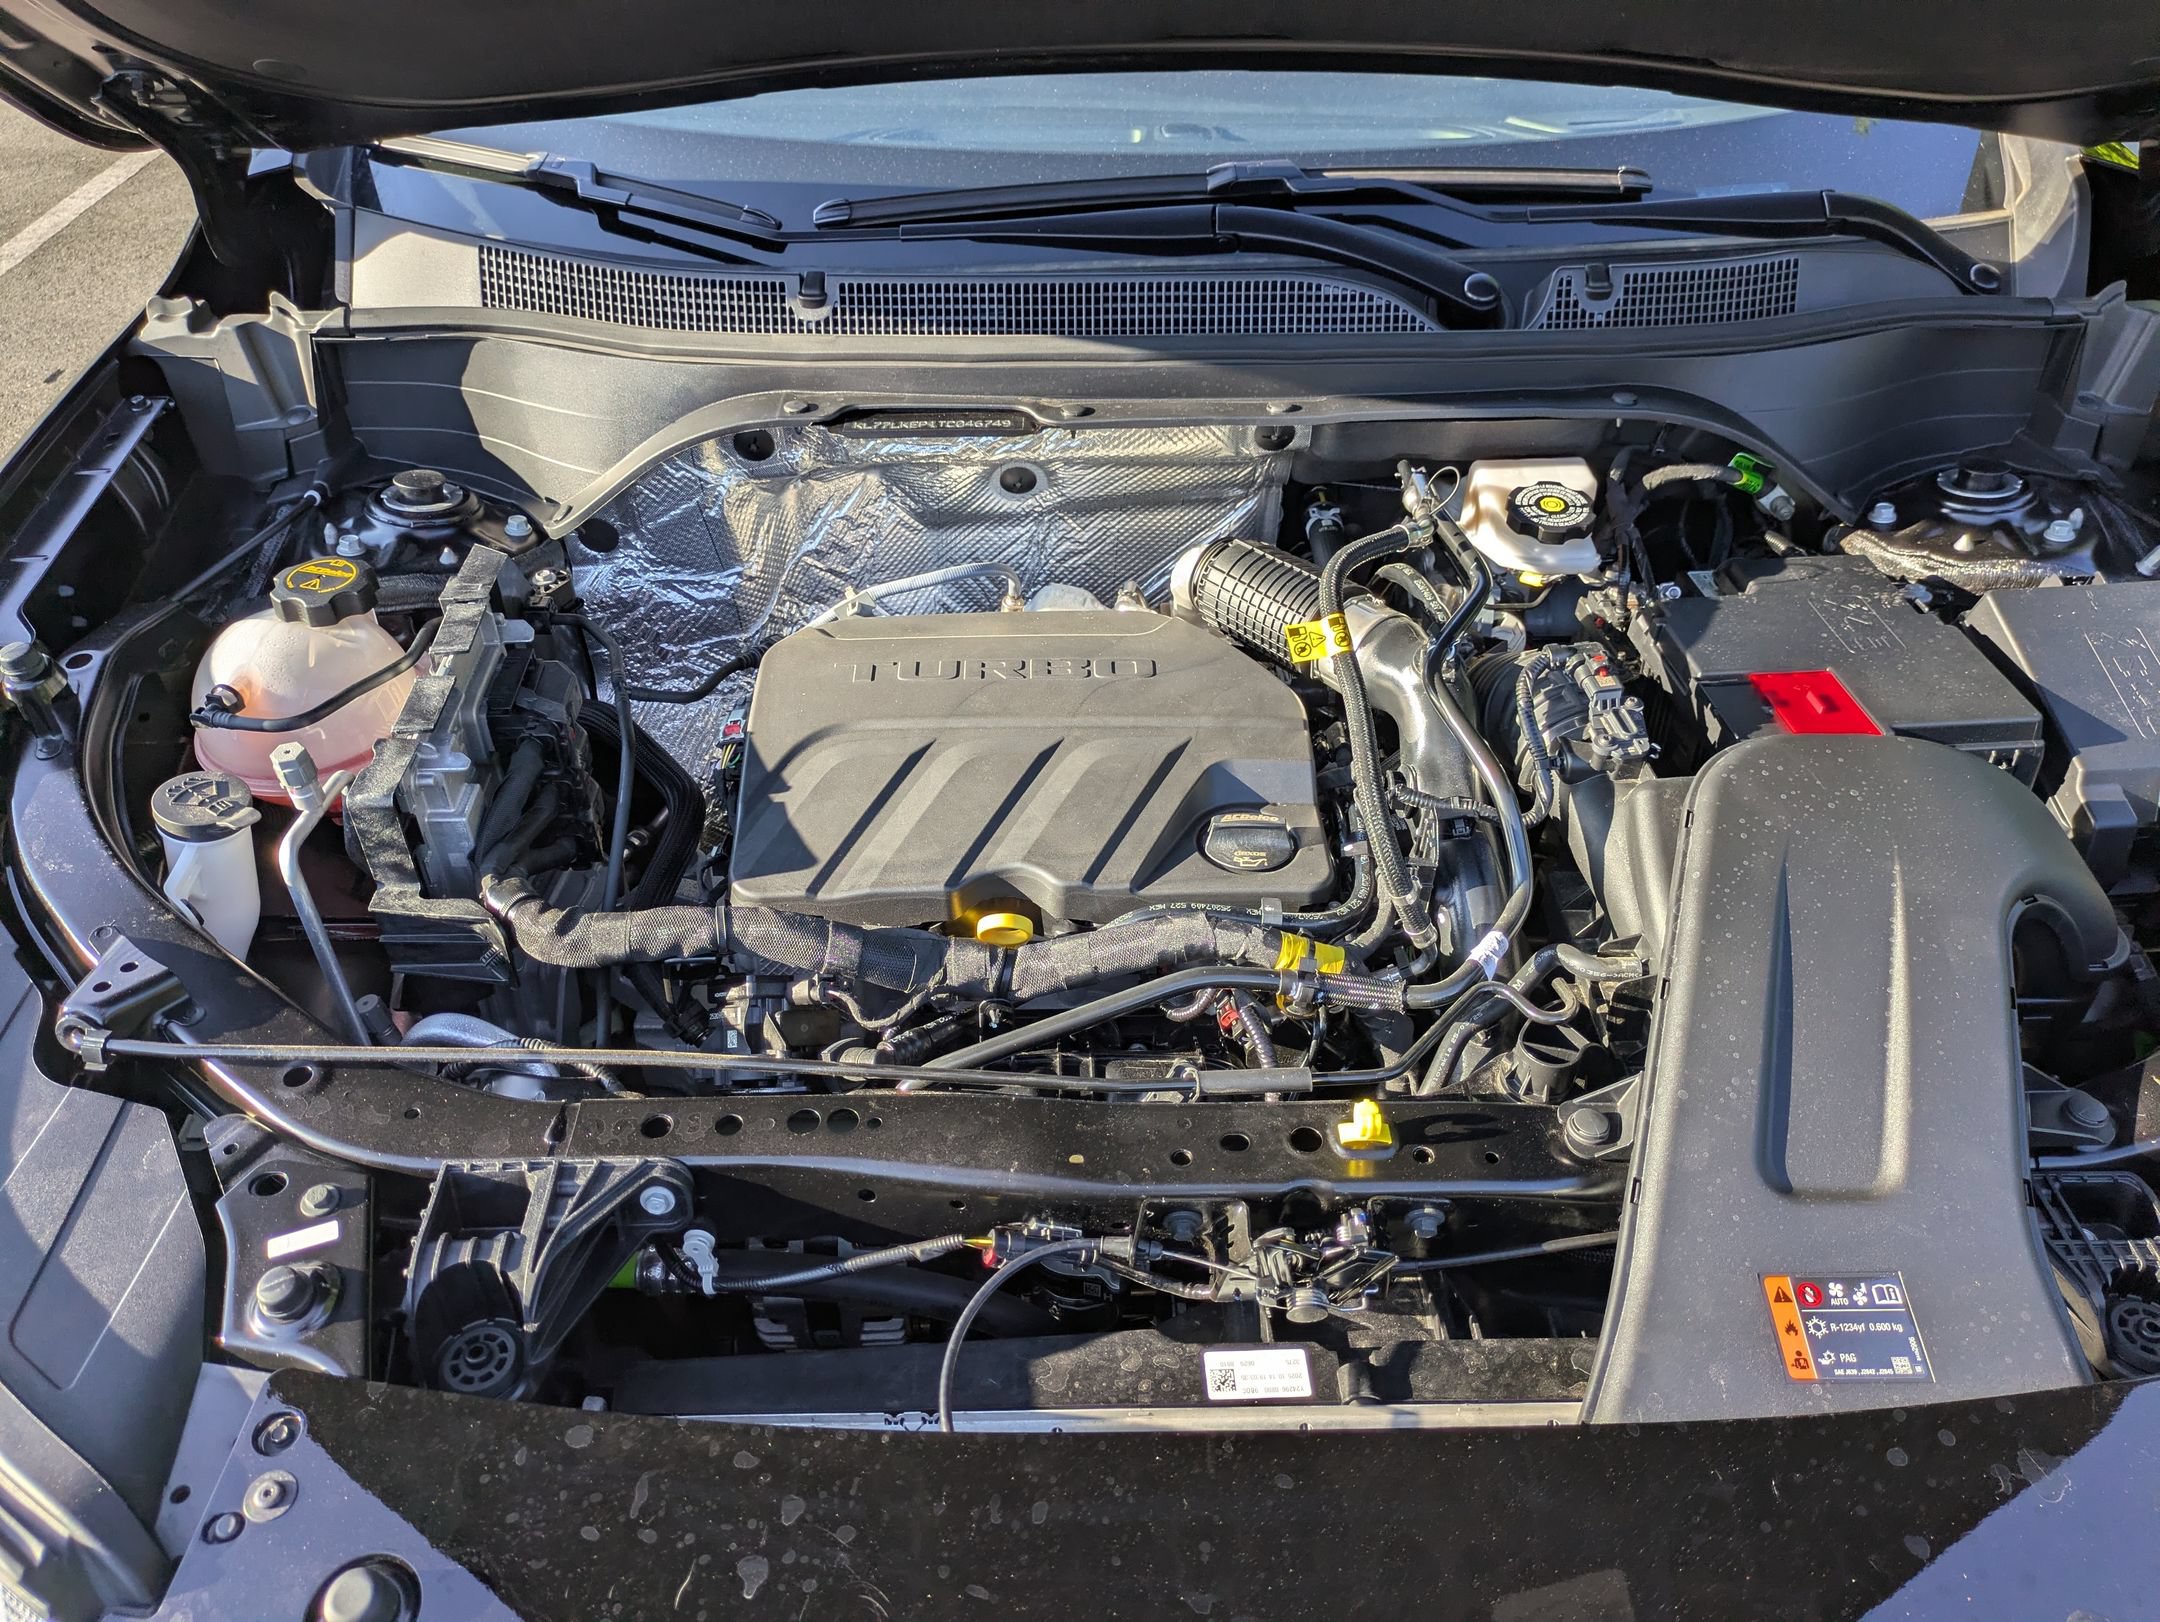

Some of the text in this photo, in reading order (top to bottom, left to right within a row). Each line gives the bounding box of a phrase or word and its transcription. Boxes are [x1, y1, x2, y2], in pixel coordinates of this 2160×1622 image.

[833, 657, 1157, 683] TURBO
[1220, 813, 1279, 822] ACDelco
[1148, 903, 1166, 911] MEX
[1190, 902, 1232, 912] 25207409
[1831, 1297, 1849, 1306] AUTO
[1829, 1322, 1904, 1333] R-1234yf 0.600 kg
[1839, 1353, 1857, 1363] PAG
